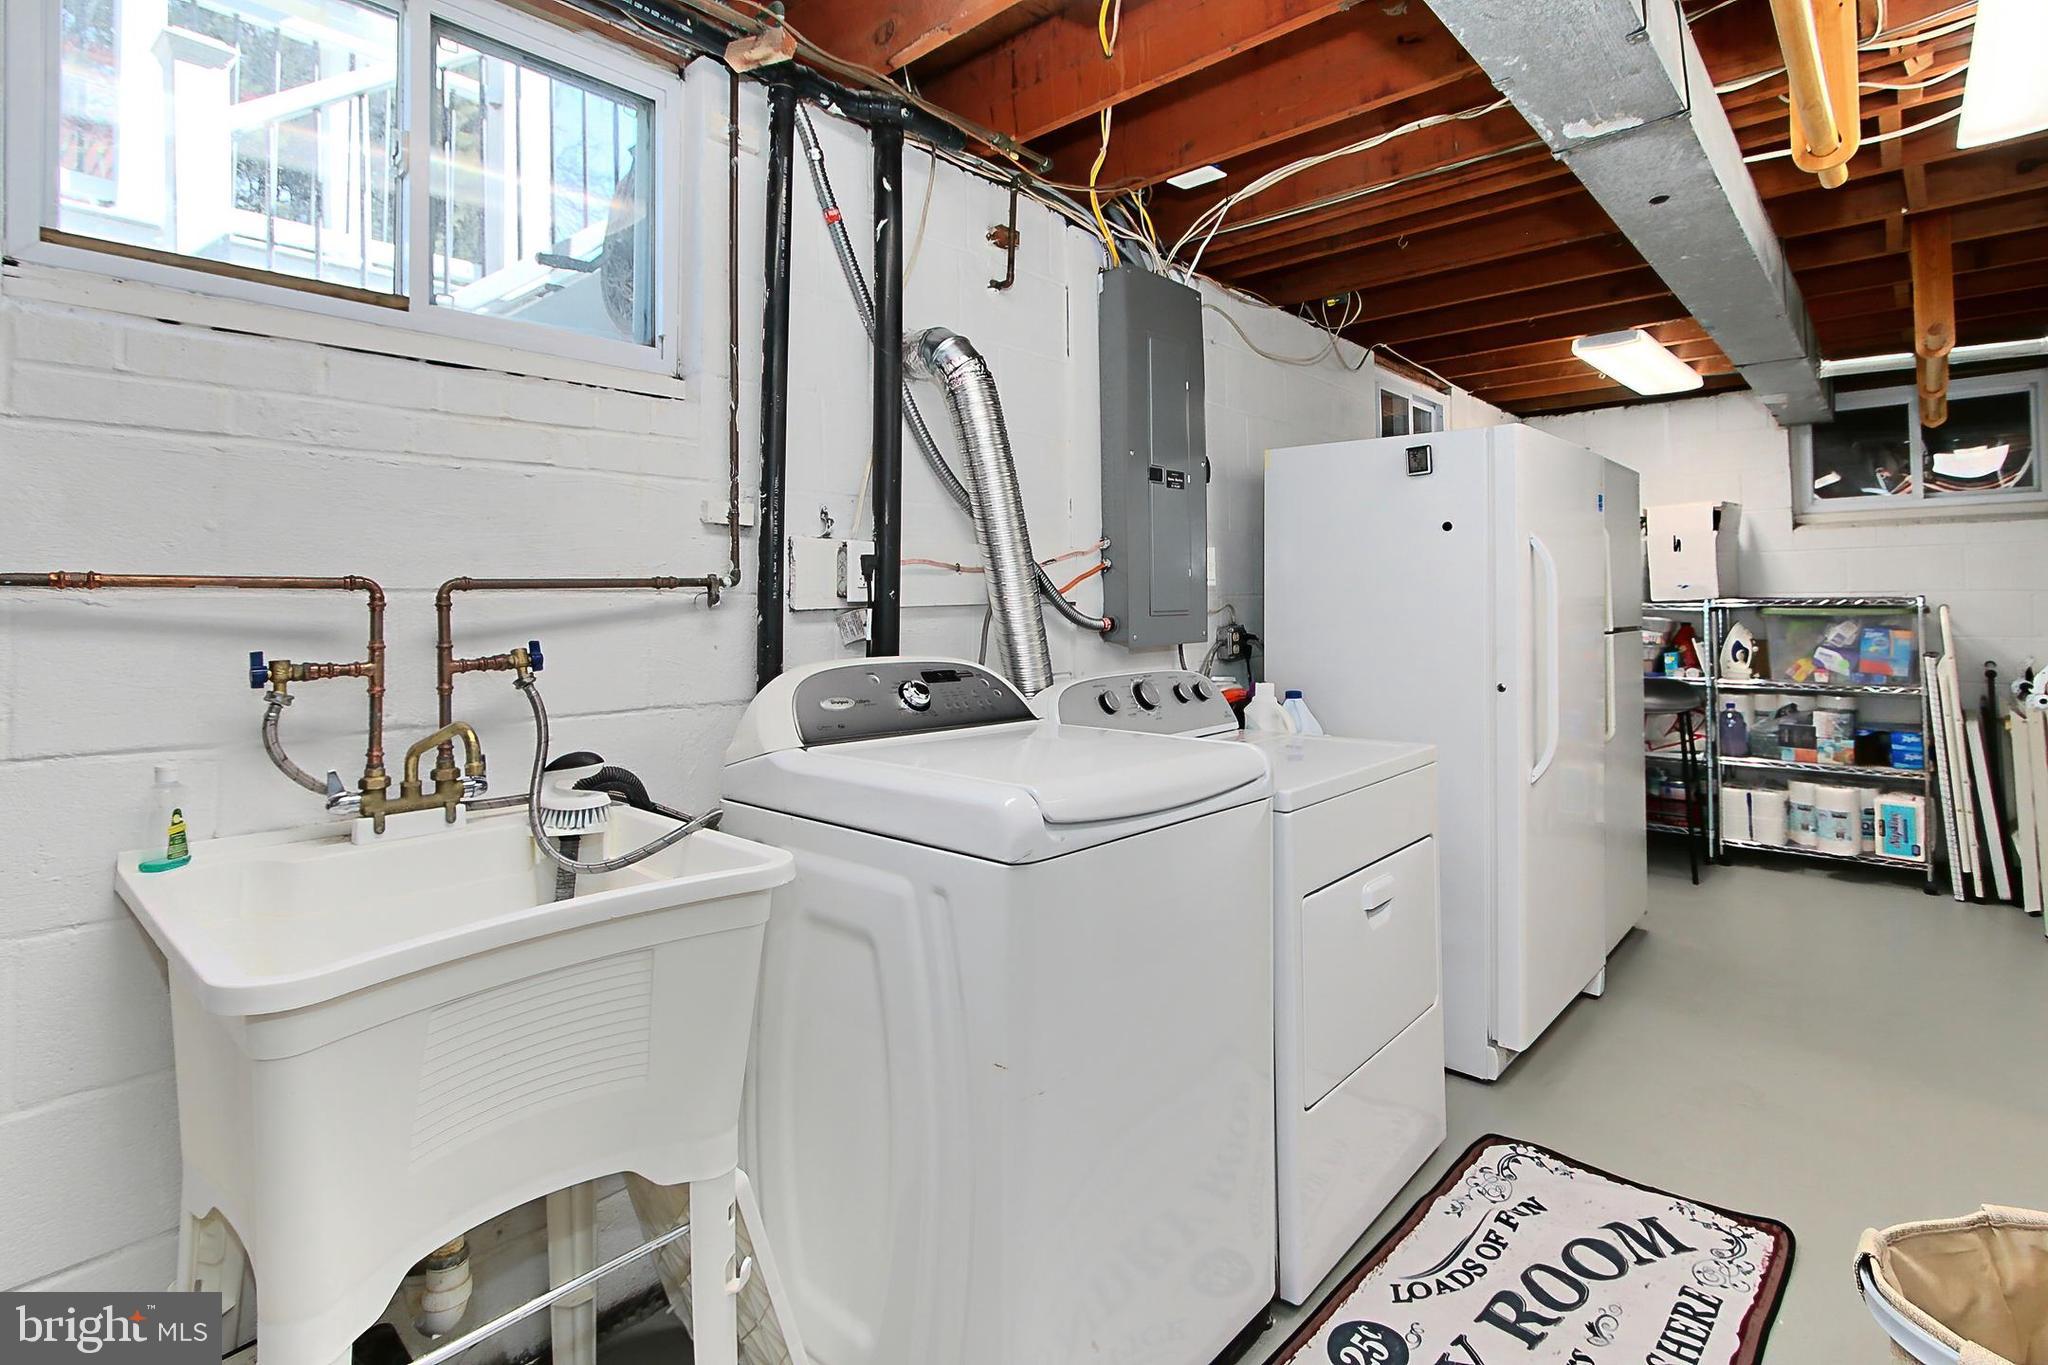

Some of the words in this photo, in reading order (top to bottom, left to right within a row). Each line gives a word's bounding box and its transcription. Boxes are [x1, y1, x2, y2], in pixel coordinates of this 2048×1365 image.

[1390, 1258, 1488, 1303] LOADS
[1475, 1229, 1509, 1260] OF
[1494, 1196, 1548, 1232] FUN
[1474, 1216, 1699, 1350] ROOM
